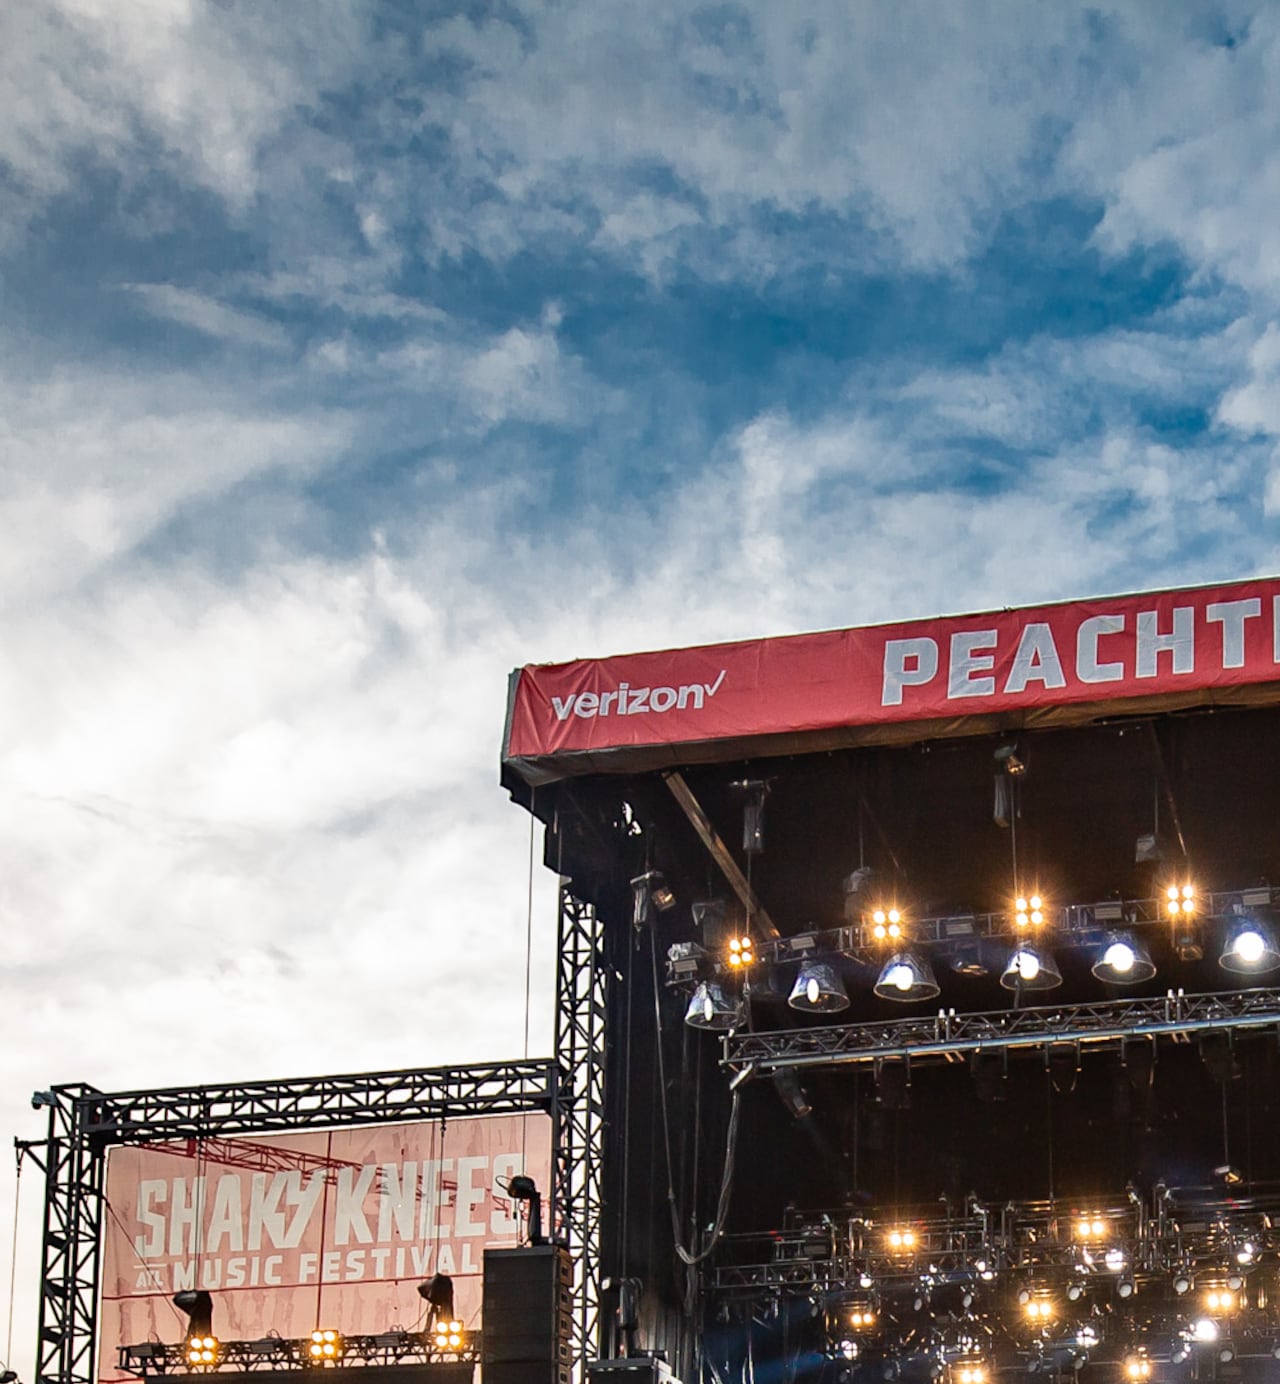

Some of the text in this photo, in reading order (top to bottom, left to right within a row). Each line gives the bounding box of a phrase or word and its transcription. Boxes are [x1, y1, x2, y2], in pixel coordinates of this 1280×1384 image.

[552, 681, 704, 721] verizon
[135, 1152, 528, 1258] SHAKY KNEES
[173, 1254, 286, 1292] MUSIC
[299, 1243, 479, 1283] FESTIVAL
